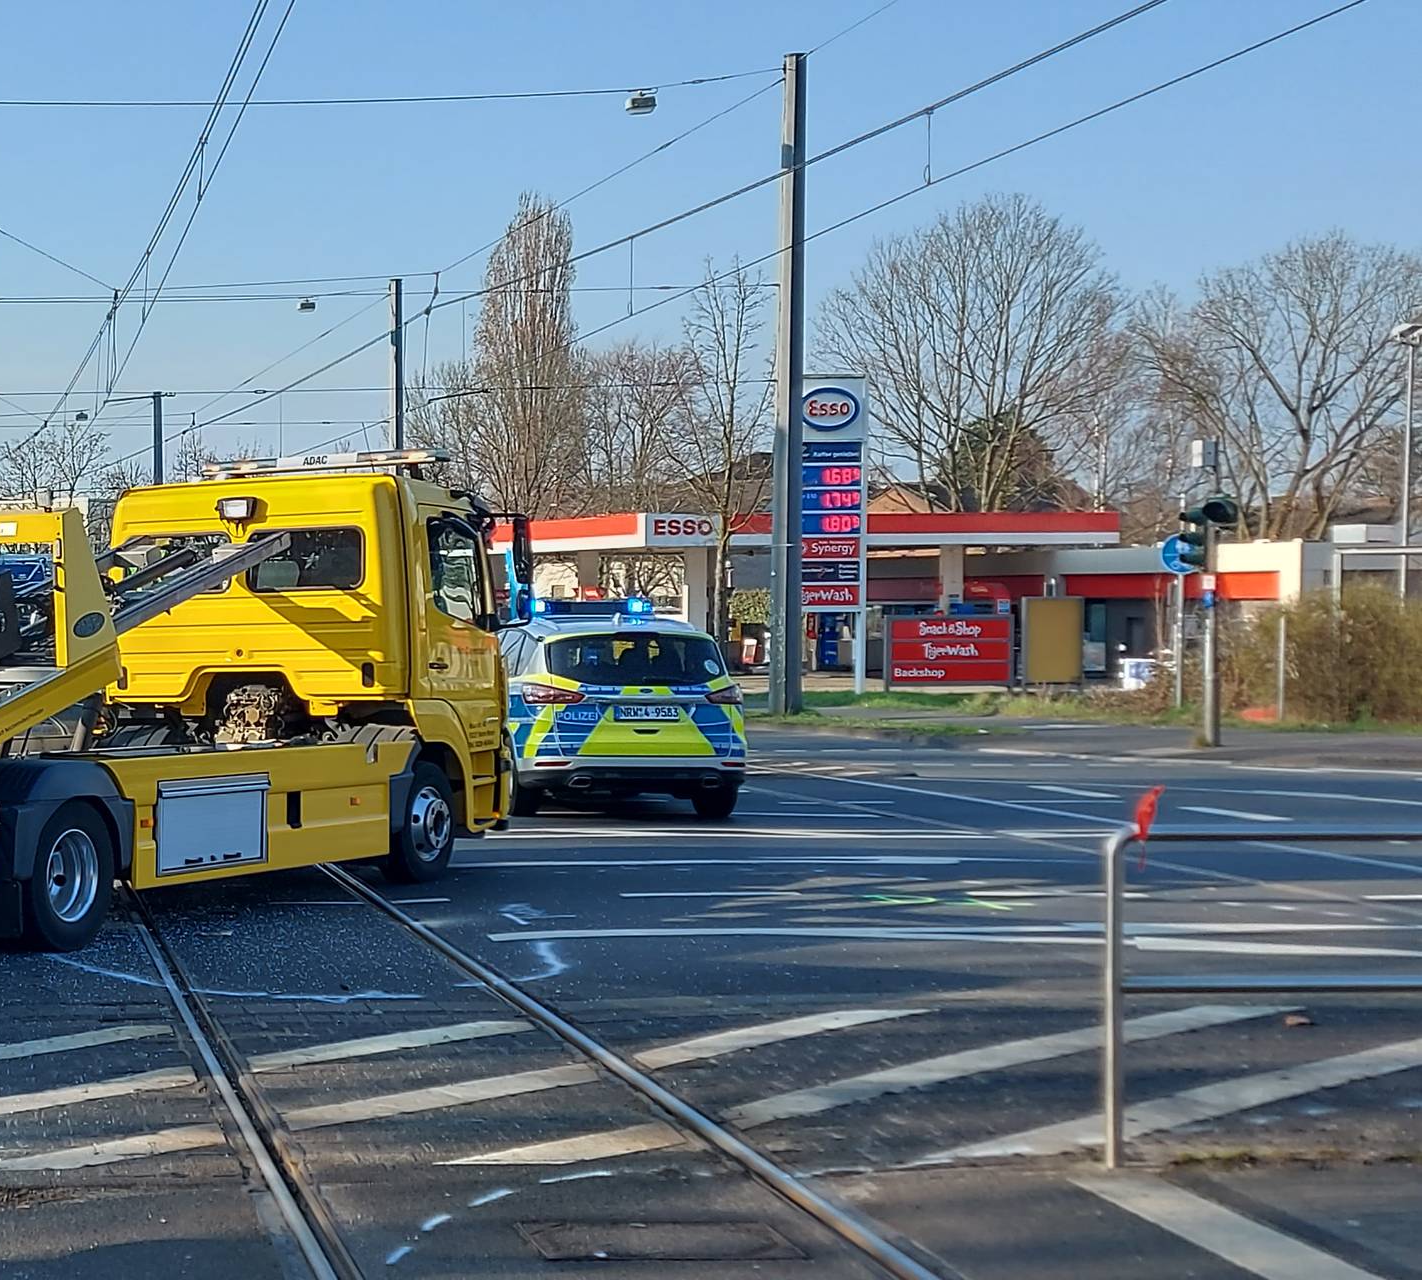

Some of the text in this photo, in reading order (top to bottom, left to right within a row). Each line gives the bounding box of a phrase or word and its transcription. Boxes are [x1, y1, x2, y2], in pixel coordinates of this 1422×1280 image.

[303, 455, 328, 466] ADAC
[653, 519, 713, 536] ESSO
[811, 543, 855, 555] Synergy
[894, 667, 945, 678] Backshop
[558, 711, 598, 721] POLIZEI
